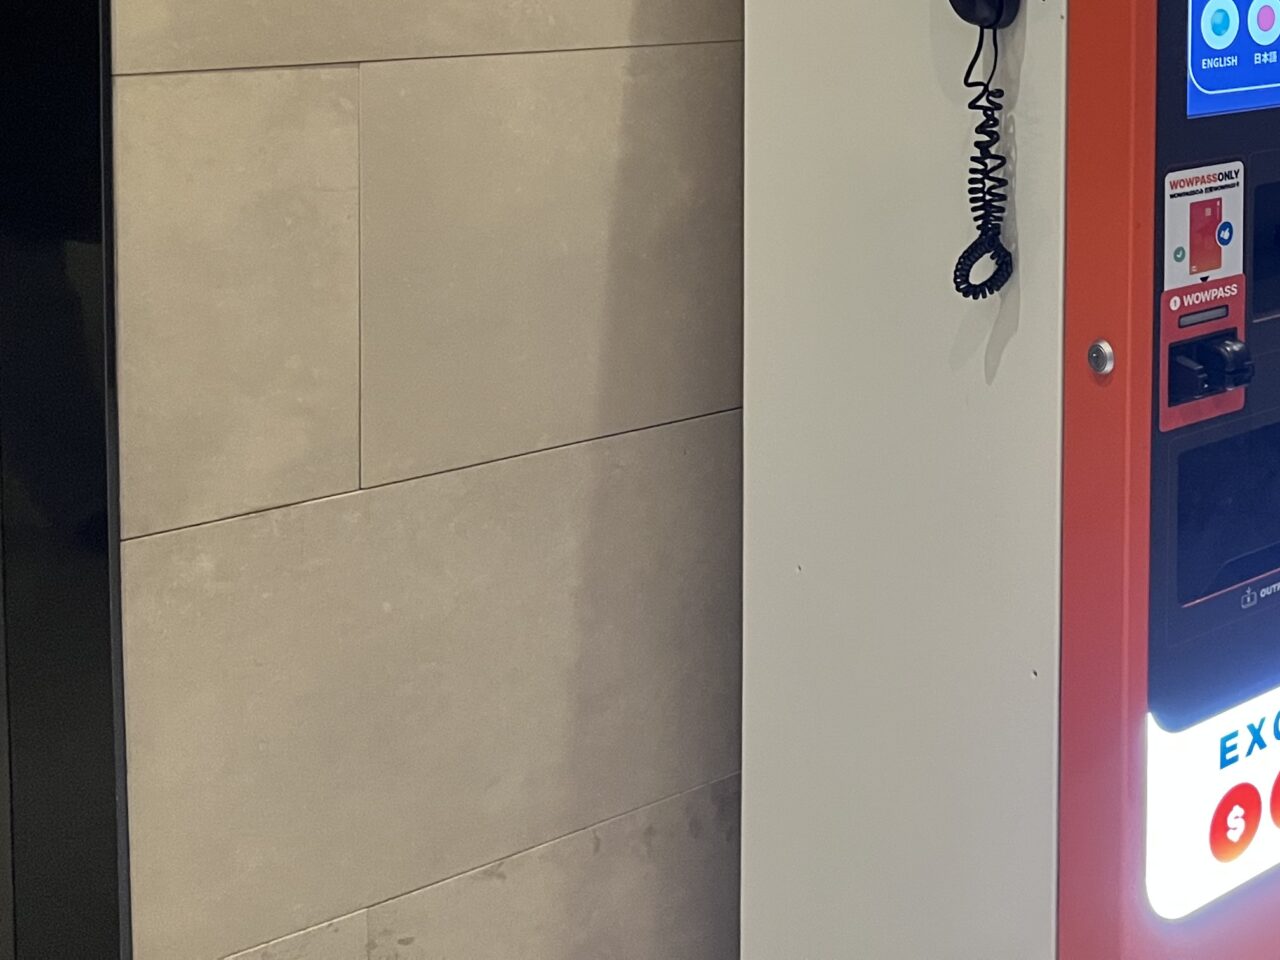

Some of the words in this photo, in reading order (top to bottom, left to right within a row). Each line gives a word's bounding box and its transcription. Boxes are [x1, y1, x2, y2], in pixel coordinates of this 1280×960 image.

[1201, 55, 1238, 69] ENGLISH
[1254, 51, 1277, 65] 日本語
[1183, 283, 1238, 307] WOWPASS
